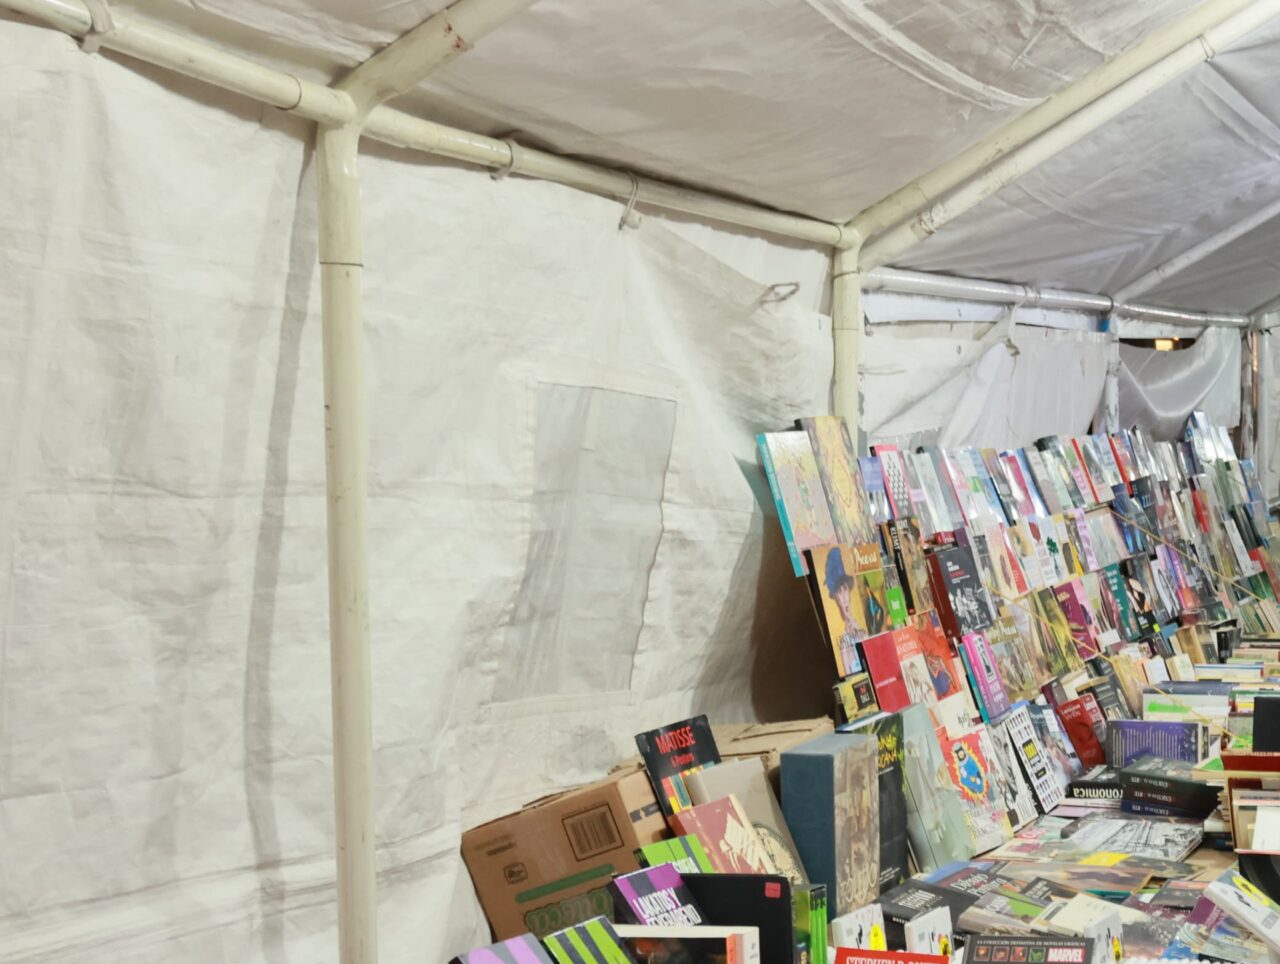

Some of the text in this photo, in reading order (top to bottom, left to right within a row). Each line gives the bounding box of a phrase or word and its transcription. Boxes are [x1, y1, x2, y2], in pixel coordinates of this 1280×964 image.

[655, 726, 696, 754] MATISSE
[633, 889, 677, 919] LAKATOS
[1047, 947, 1084, 963] MARVEL
